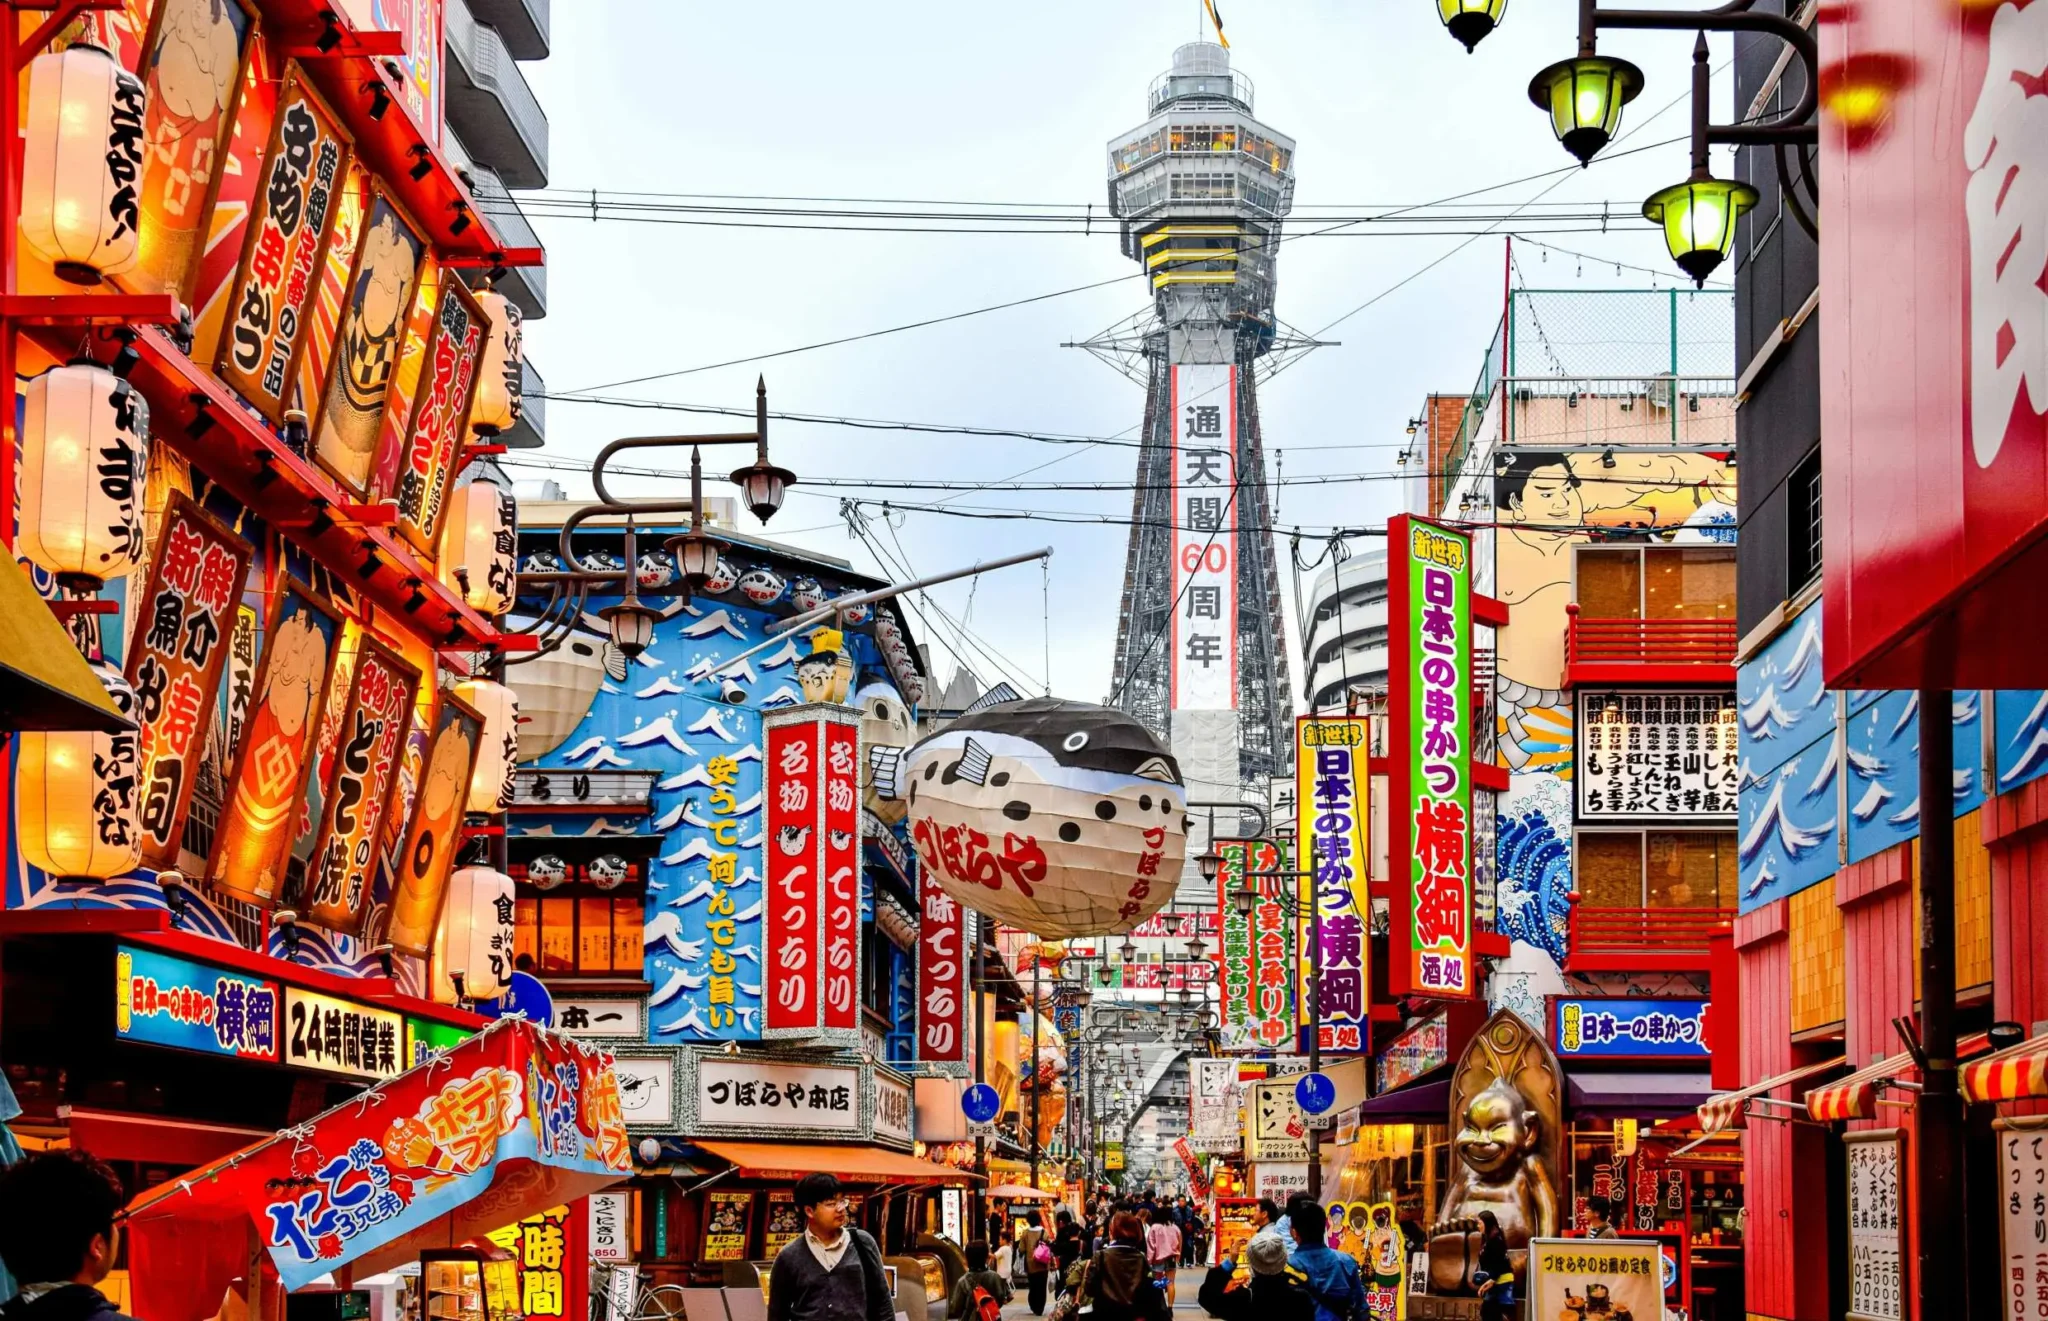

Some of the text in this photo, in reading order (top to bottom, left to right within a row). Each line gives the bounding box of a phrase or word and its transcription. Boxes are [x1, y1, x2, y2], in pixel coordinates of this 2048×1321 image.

[235, 103, 317, 371] 名物串かつ
[1181, 405, 1227, 668] 通天閣60周年
[1413, 530, 1465, 571] 新世界
[162, 520, 237, 613] 新鮮
[148, 591, 218, 671] 魚介
[1420, 568, 1458, 797] 日本一の串かつ
[1304, 725, 1361, 746] 新世界
[347, 681, 405, 911] 大阪下町の味
[1587, 753, 1603, 811] もち
[1607, 753, 1625, 811] うずら玉子
[1626, 753, 1644, 811] 紅しょうが
[1645, 753, 1662, 811] にんにく
[1664, 753, 1682, 811] 玉ねぎ
[1684, 753, 1701, 811] 山芋
[1703, 753, 1721, 811] しし唐
[1722, 753, 1738, 811] れんこん
[914, 816, 1047, 897] づぼらや
[1315, 750, 1352, 909] 日本一の串かつ
[706, 753, 742, 1028] 安うて何んでも旨い
[778, 740, 809, 1012] 名物 てっちり
[828, 740, 855, 1012] 名物 てっちり
[1118, 825, 1167, 920] づぼらや
[1414, 798, 1466, 950] 横綱
[1306, 915, 1363, 1020] 横綱
[1421, 953, 1464, 987] 酒処
[132, 977, 213, 1025] 日本一の串かつ
[215, 977, 275, 1055] 横綱
[290, 1001, 396, 1074] 24時間営業
[552, 1005, 623, 1030] 本一
[1583, 1015, 1696, 1040] 日本一の串かつ
[707, 1079, 850, 1112] づぼらや本店
[1303, 1119, 1328, 1127] 9-22
[969, 1126, 993, 1135] 9-22
[333, 1190, 404, 1240] 3兄弟
[2031, 1137, 2047, 1243] てっちり
[595, 1249, 617, 1257] 850
[2008, 1139, 2025, 1321] てっさ 一四〇〇
[1544, 1255, 1651, 1274] づぼらやのお薦め定食
